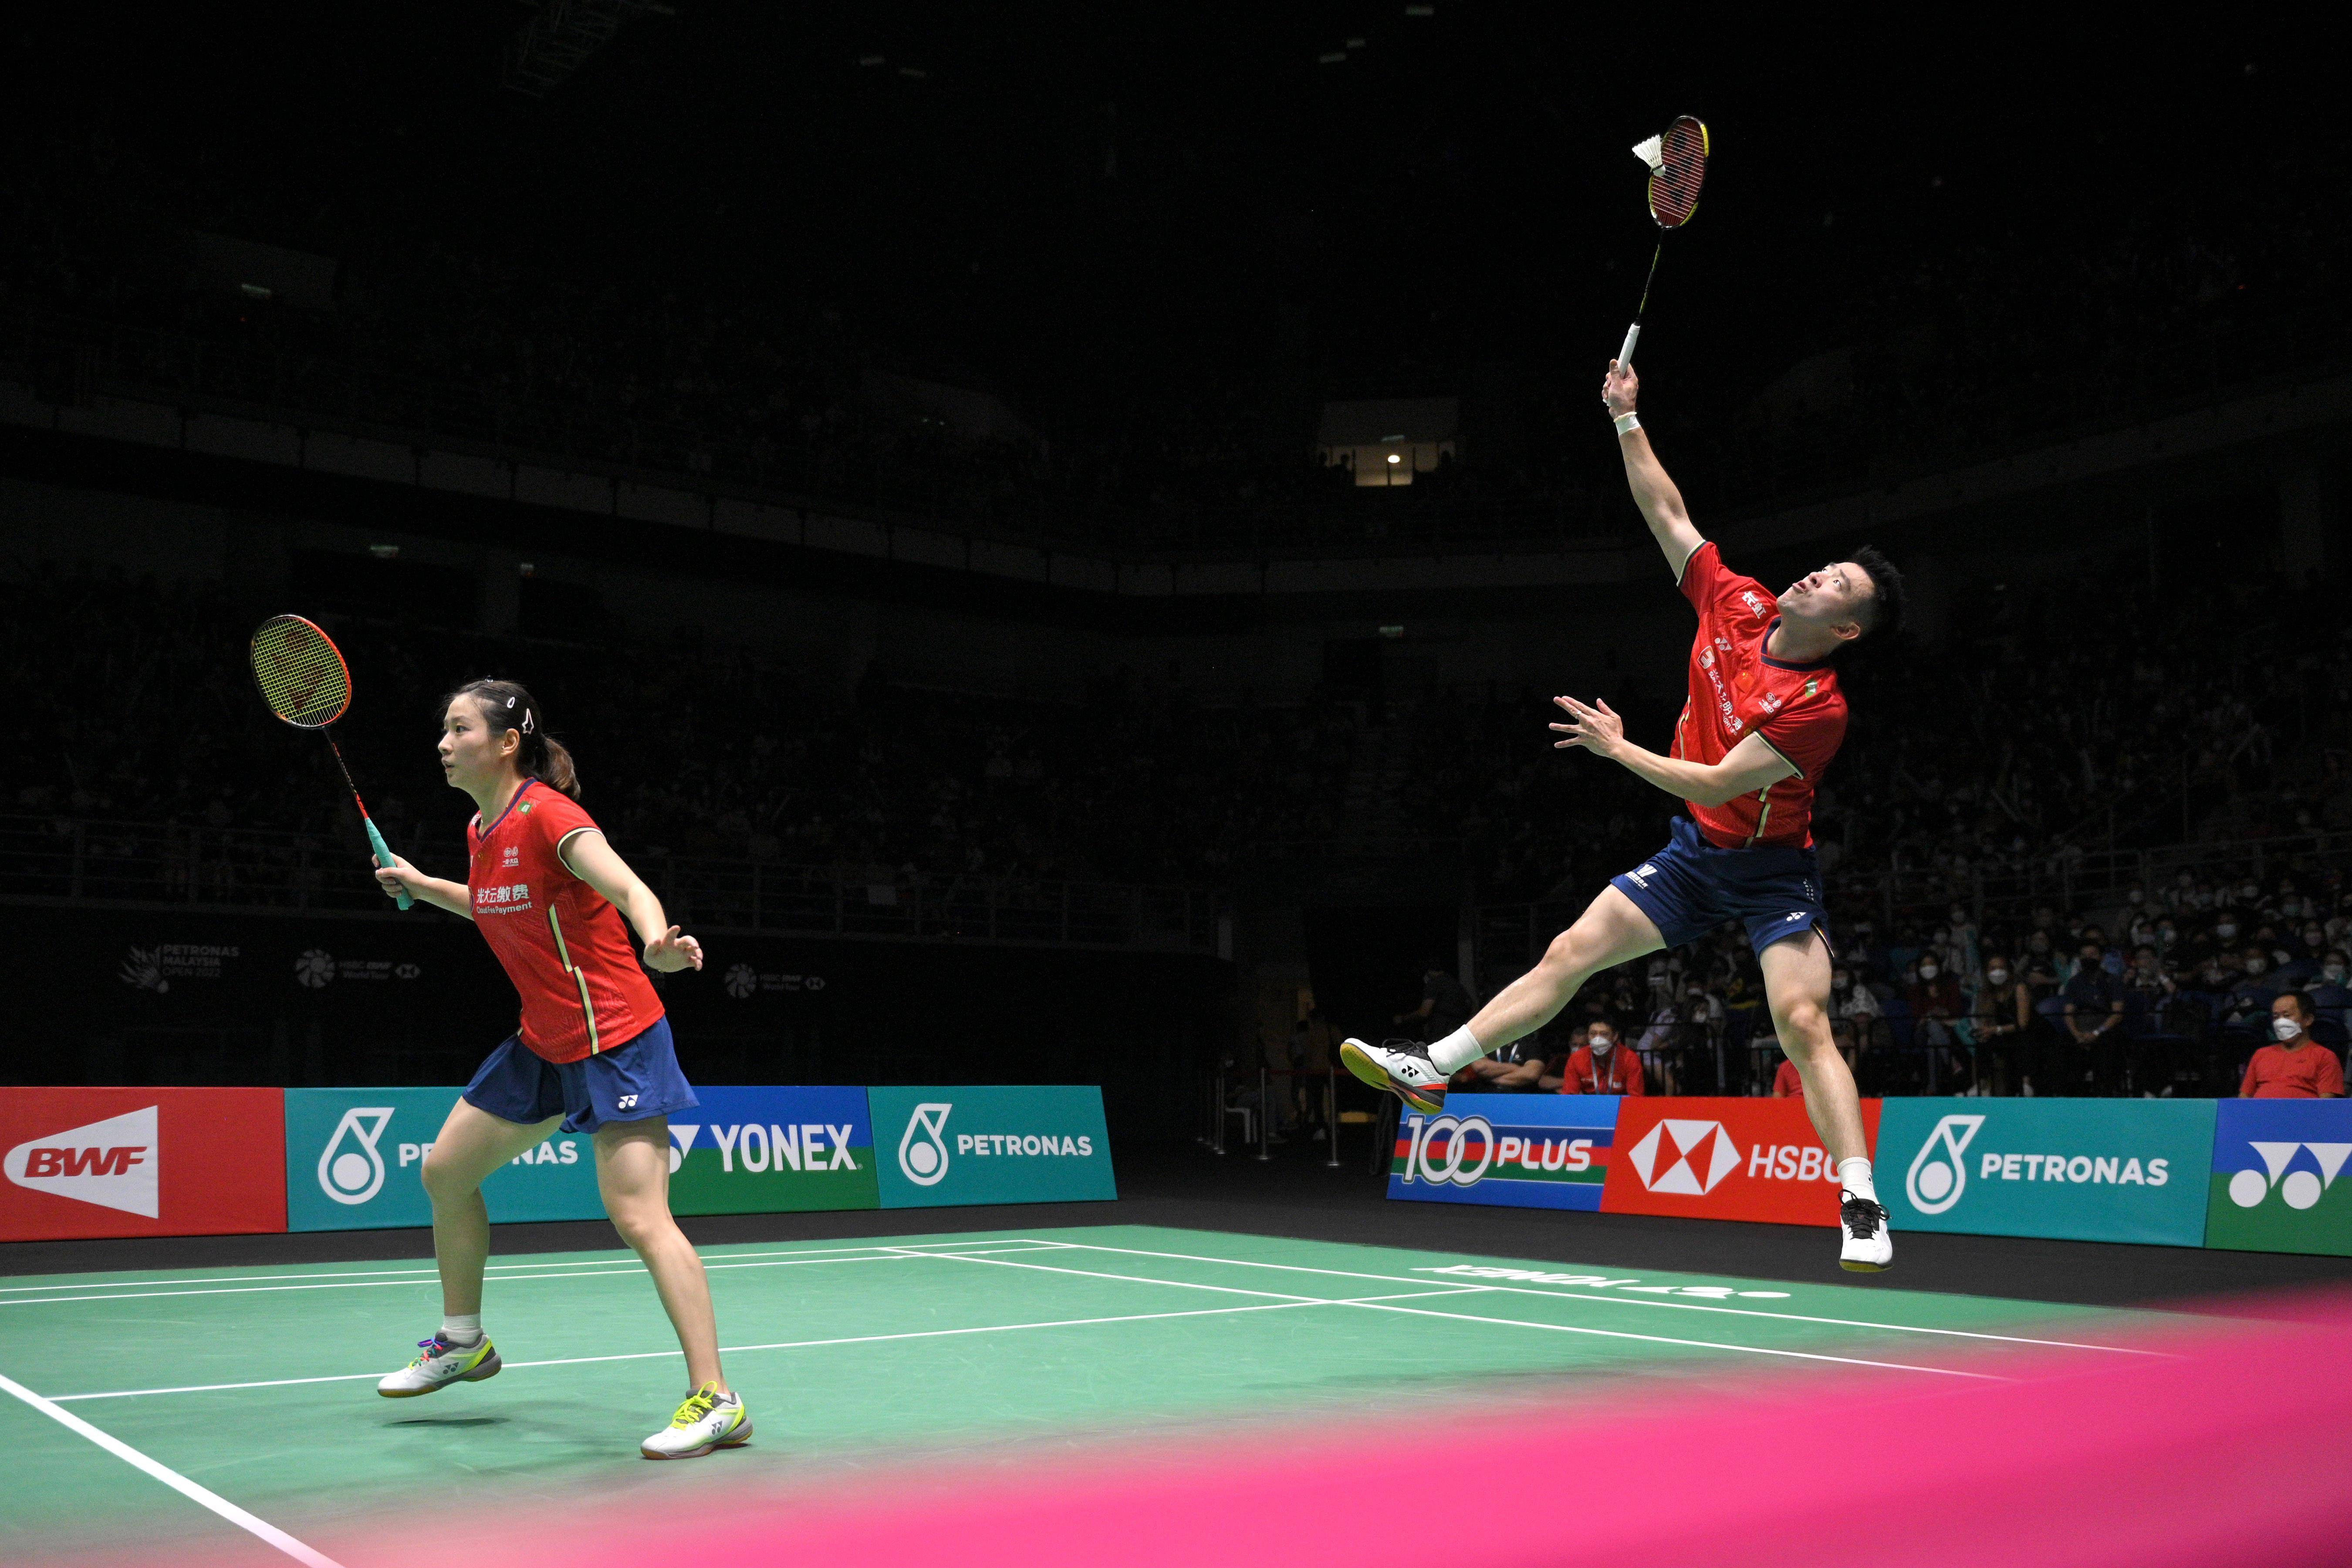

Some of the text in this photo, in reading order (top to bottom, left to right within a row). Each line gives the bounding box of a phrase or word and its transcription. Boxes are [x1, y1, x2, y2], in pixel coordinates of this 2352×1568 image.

[476, 884, 530, 903] 光大云缴费
[496, 901, 532, 915] Payment
[163, 944, 240, 957] PETRONAS
[162, 956, 221, 966] MALAYSIA
[710, 1124, 855, 1173] YONEX
[958, 1135, 1092, 1156] PETRONAS
[24, 1147, 147, 1178] BWF
[1980, 1153, 2169, 1186] PETRONAS
